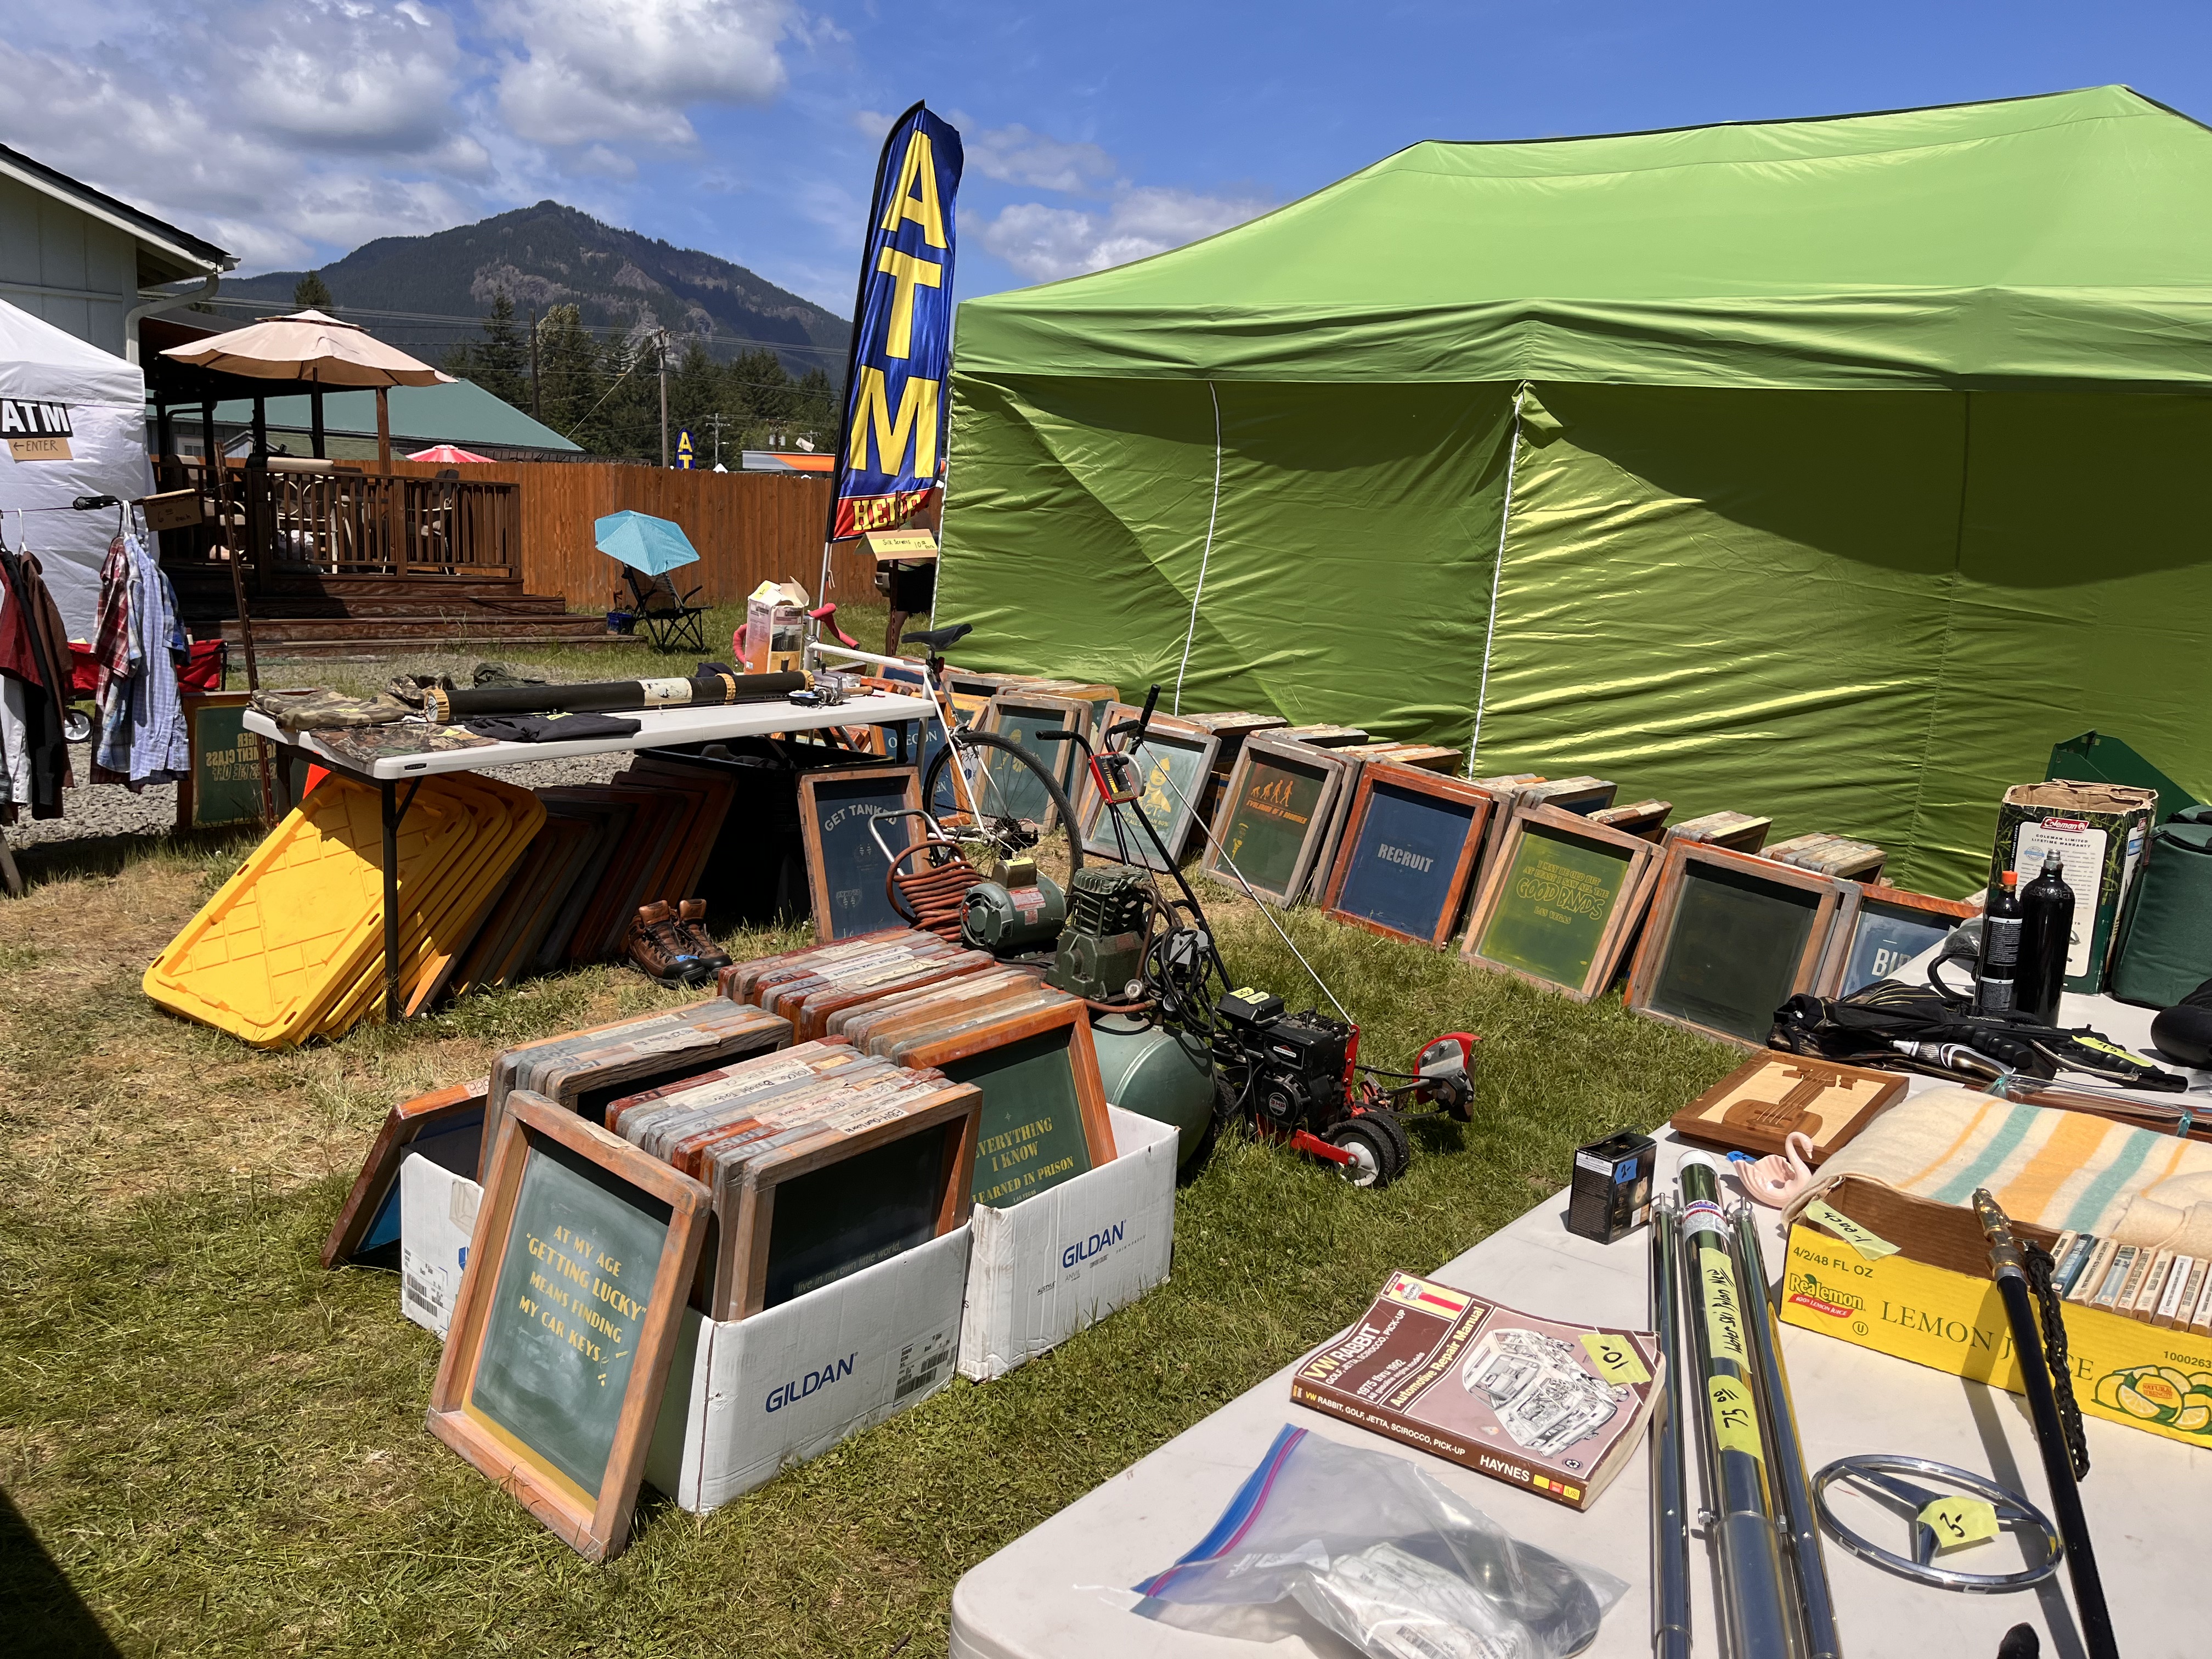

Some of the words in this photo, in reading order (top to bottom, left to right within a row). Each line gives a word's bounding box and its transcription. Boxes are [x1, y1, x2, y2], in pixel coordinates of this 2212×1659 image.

[849, 130, 947, 478] ATM
[2, 400, 70, 432] ATM
[26, 439, 58, 452] ENTER
[679, 431, 692, 468] AT
[888, 730, 938, 748] OEGN
[825, 808, 846, 832] GET
[2044, 818, 2078, 831] Coleman
[1378, 843, 1434, 873] RECRUIT
[1543, 862, 1559, 872] MAY
[1559, 866, 1570, 877] BE
[1570, 871, 1585, 881] OLD
[1585, 875, 1601, 886] BUT
[1516, 877, 1559, 901] GOOD
[1557, 886, 1605, 920] BANDS
[1523, 866, 1535, 874] AT
[1534, 870, 1558, 882] LEAST
[1562, 878, 1579, 889] SAW
[1594, 887, 1610, 899] THE
[1534, 906, 1548, 917] LAS
[1549, 911, 1572, 924] VEGAS
[976, 1116, 1053, 1159] VERYTHING
[992, 1156, 998, 1172] I
[1001, 1141, 1039, 1169] KNOW
[1023, 1171, 1036, 1186] IN
[1037, 1156, 1074, 1181] PRISON
[1013, 1194, 1023, 1203] LAS
[1023, 1189, 1037, 1200] VEGAS
[554, 1225, 571, 1244] AT
[573, 1236, 594, 1259] MY
[596, 1252, 622, 1277] AGE
[1062, 1220, 1124, 1268] GILDAN
[526, 1233, 590, 1289] "GETTING
[592, 1277, 647, 1321] LUCKY"
[798, 1279, 812, 1293] live
[815, 1275, 822, 1286] in
[825, 1269, 838, 1281] my
[839, 1261, 856, 1275] own
[859, 1252, 876, 1267] little
[878, 1240, 901, 1259] world,
[1065, 1269, 1081, 1282] ANVIL
[1793, 1246, 1829, 1266] 4/2/48
[1833, 1259, 1849, 1272] FL
[1854, 1265, 1874, 1278] OZ
[529, 1271, 569, 1307] MEANS
[571, 1299, 622, 1344] FINDING
[1796, 1296, 1810, 1304] 100%
[1810, 1300, 1830, 1313] LEMON
[1830, 1306, 1848, 1316] JUICE
[519, 1295, 539, 1318] MY
[541, 1312, 565, 1339] CAR
[568, 1329, 601, 1362] KEYS
[1880, 1300, 1995, 1351] LEMON
[1303, 1355, 1340, 1379] VW
[1331, 1322, 1381, 1362] RABBIT
[1325, 1366, 1346, 1385] GOLF,
[1383, 1308, 1406, 1336] PICK-UP
[1389, 1368, 1437, 1408] Automotive
[1430, 1339, 1461, 1373] Repair
[1453, 1305, 1486, 1342] Manual
[765, 1353, 855, 1413] GILDAN
[1357, 1379, 1378, 1396] 1975
[1373, 1367, 1390, 1385] thru
[1387, 1358, 1407, 1372] 1992
[1369, 1390, 1378, 1400] All
[1406, 1351, 1426, 1370] models
[2143, 1383, 2172, 1393] NATURAL
[2143, 1389, 2172, 1399] STRENGTH
[1305, 1391, 1317, 1401] VW
[1317, 1396, 1344, 1413] RABBIT,
[1345, 1406, 1365, 1421] GOLF,
[1366, 1414, 1390, 1429] JETTA,
[1390, 1423, 1431, 1446] SCIROCCO,
[1433, 1438, 1466, 1457] PICK-UP
[1480, 1454, 1530, 1482] HAYNES
